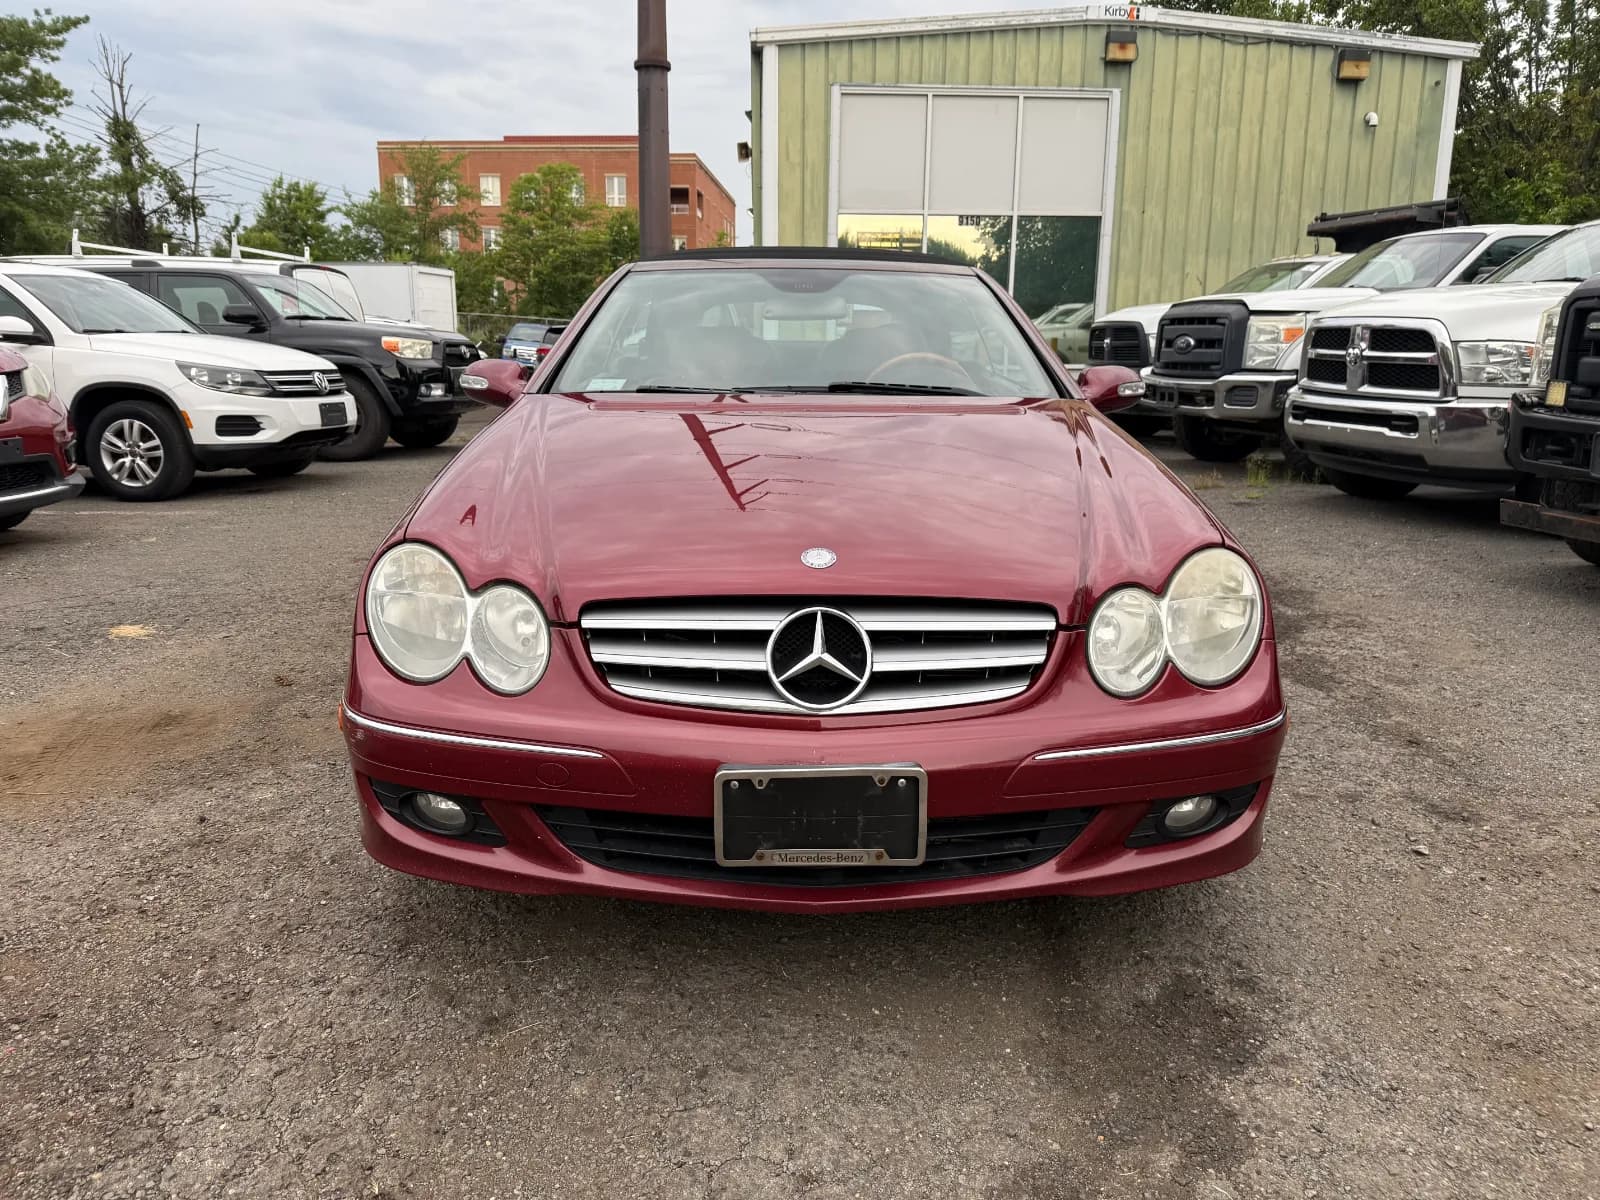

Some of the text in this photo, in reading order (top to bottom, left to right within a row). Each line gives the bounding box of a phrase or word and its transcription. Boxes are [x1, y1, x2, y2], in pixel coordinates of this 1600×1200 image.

[1104, 5, 1132, 19] Kirby
[958, 215, 981, 226] 9150
[778, 852, 864, 863] Mercedes-Benz
